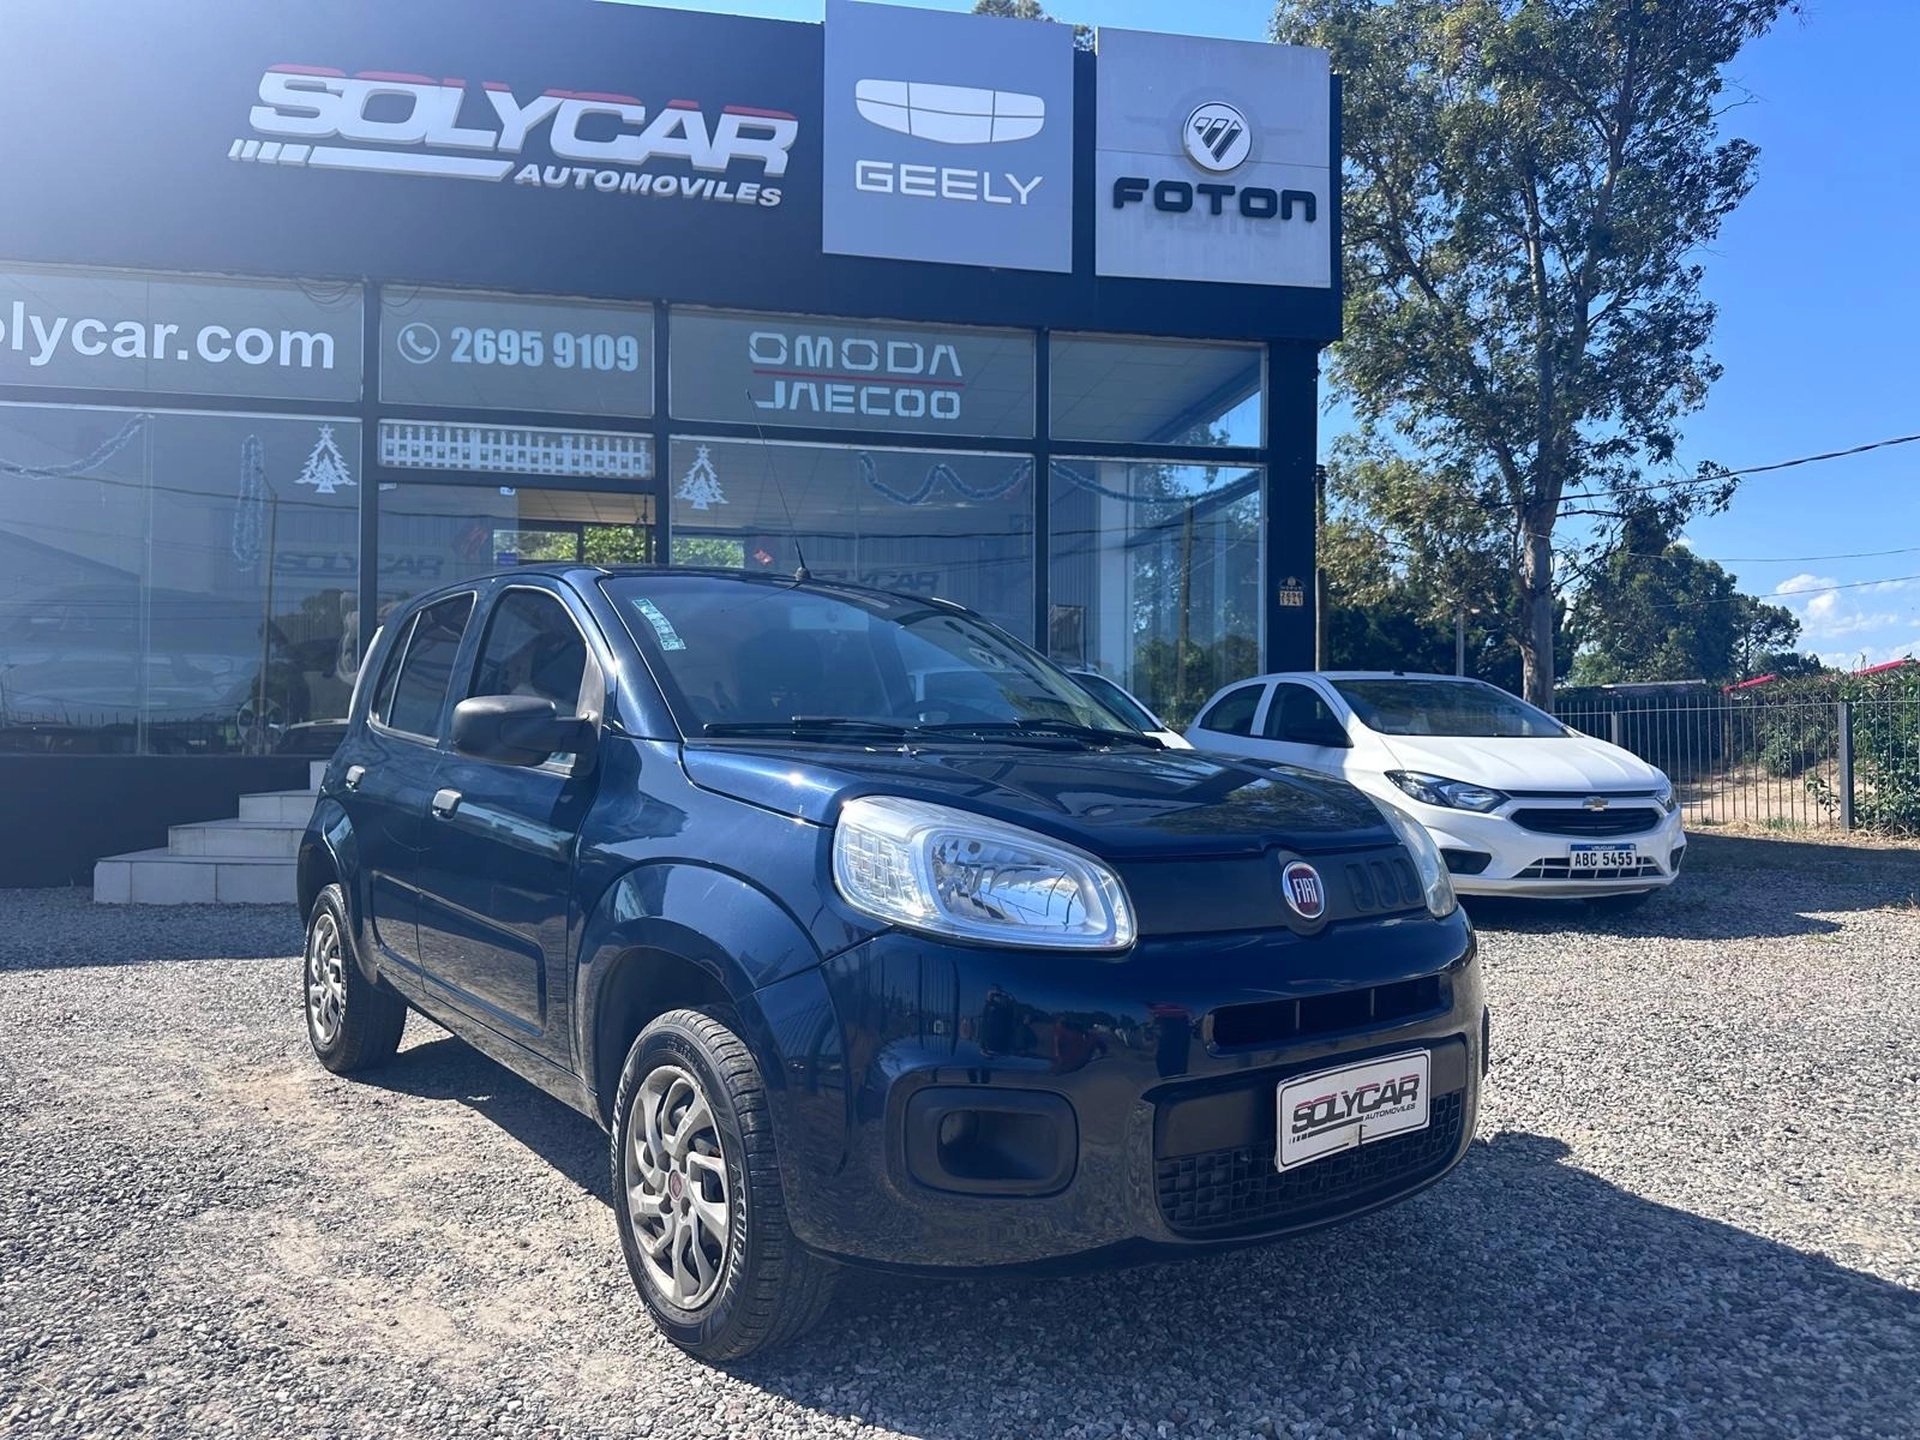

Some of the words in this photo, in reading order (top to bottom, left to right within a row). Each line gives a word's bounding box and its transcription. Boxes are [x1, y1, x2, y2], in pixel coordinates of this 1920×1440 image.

[248, 64, 799, 177] SOLYCAR
[513, 163, 783, 208] AUTOMOVILES
[855, 159, 1044, 205] GEELY
[1112, 177, 1317, 223] FOTON
[0, 300, 336, 369] lycar.com
[451, 326, 545, 366] 2695
[553, 330, 639, 372] 9109
[749, 331, 963, 377] OMODA
[755, 380, 961, 420] JAECOO
[1575, 852, 1597, 866] ABC
[1602, 852, 1633, 866] 5455
[1292, 877, 1318, 904] FIAT
[1291, 1073, 1420, 1134] SOLYCAR
[1364, 1102, 1417, 1122] AUTOMOVILES
